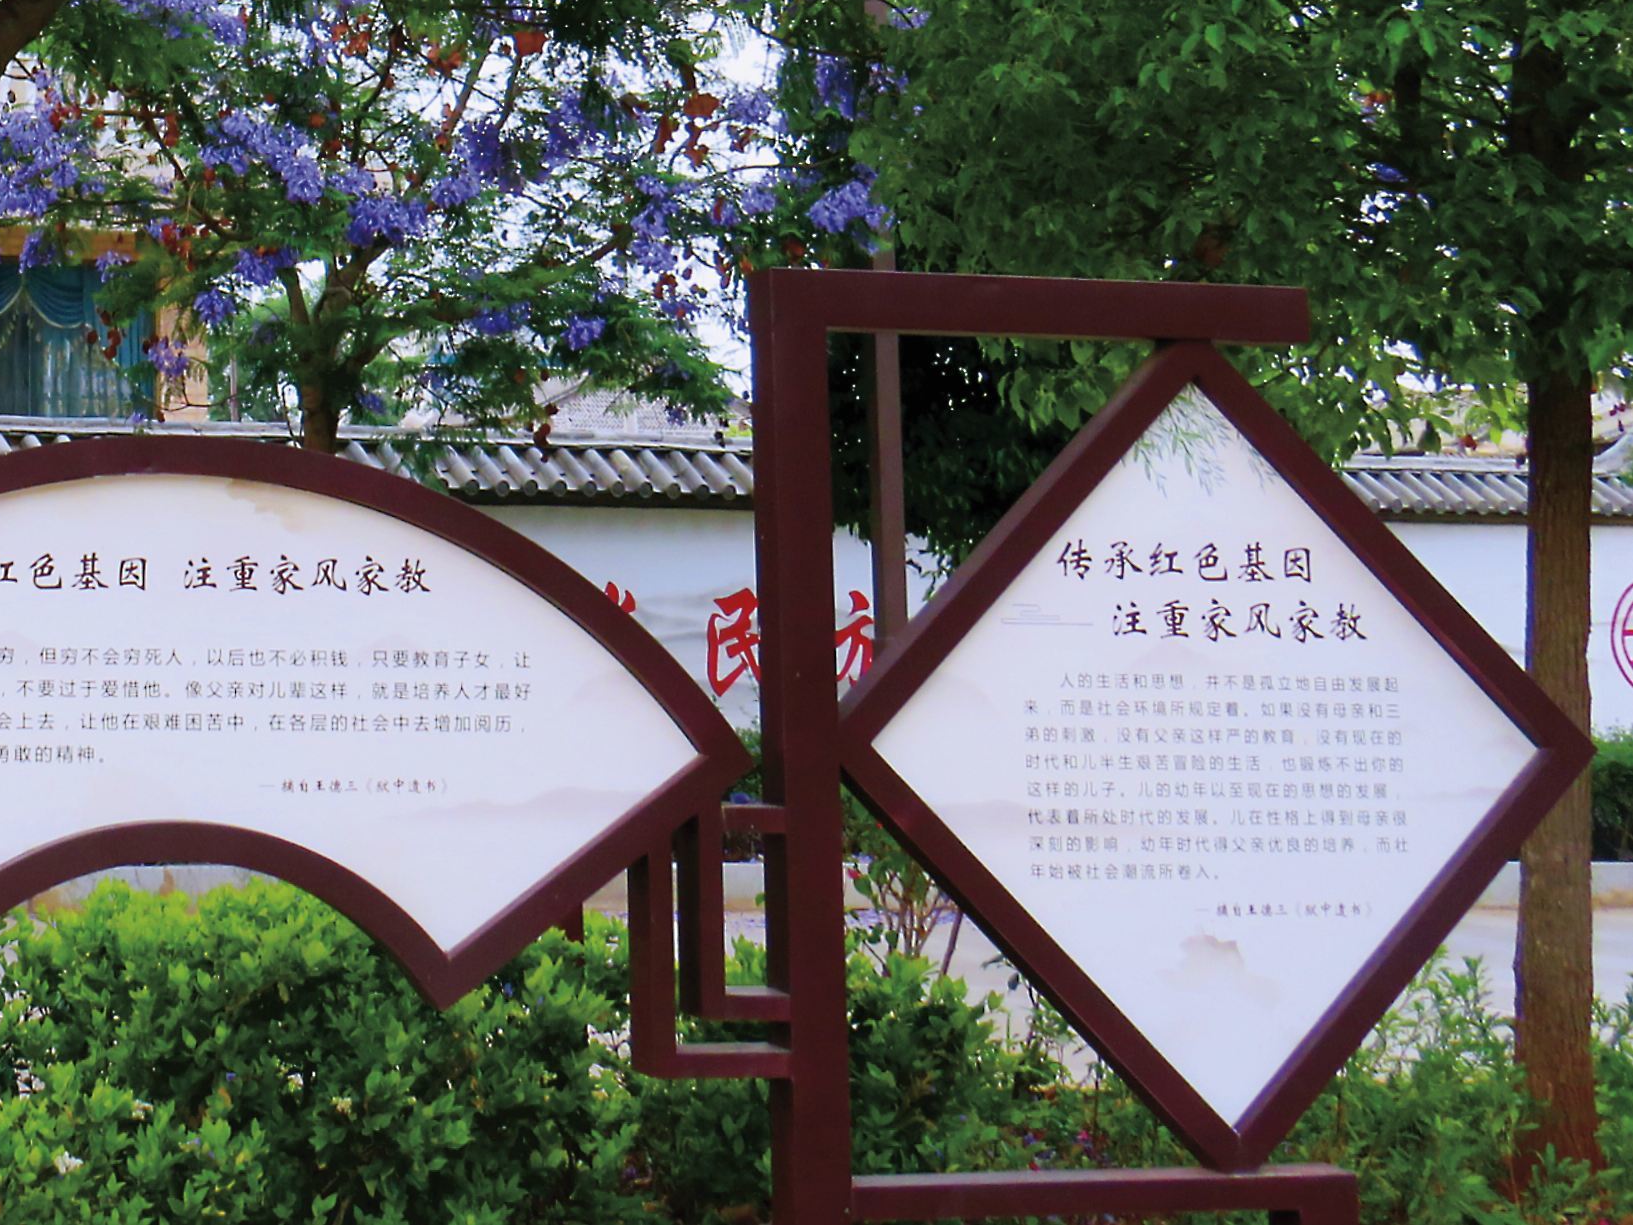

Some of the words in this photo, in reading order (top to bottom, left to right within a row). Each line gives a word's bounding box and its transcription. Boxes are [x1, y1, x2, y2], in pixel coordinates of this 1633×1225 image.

[183, 554, 431, 596] 注重家风家教
[1056, 539, 1313, 583] 传承红色基因
[1112, 599, 1368, 644] 注重家风家教
